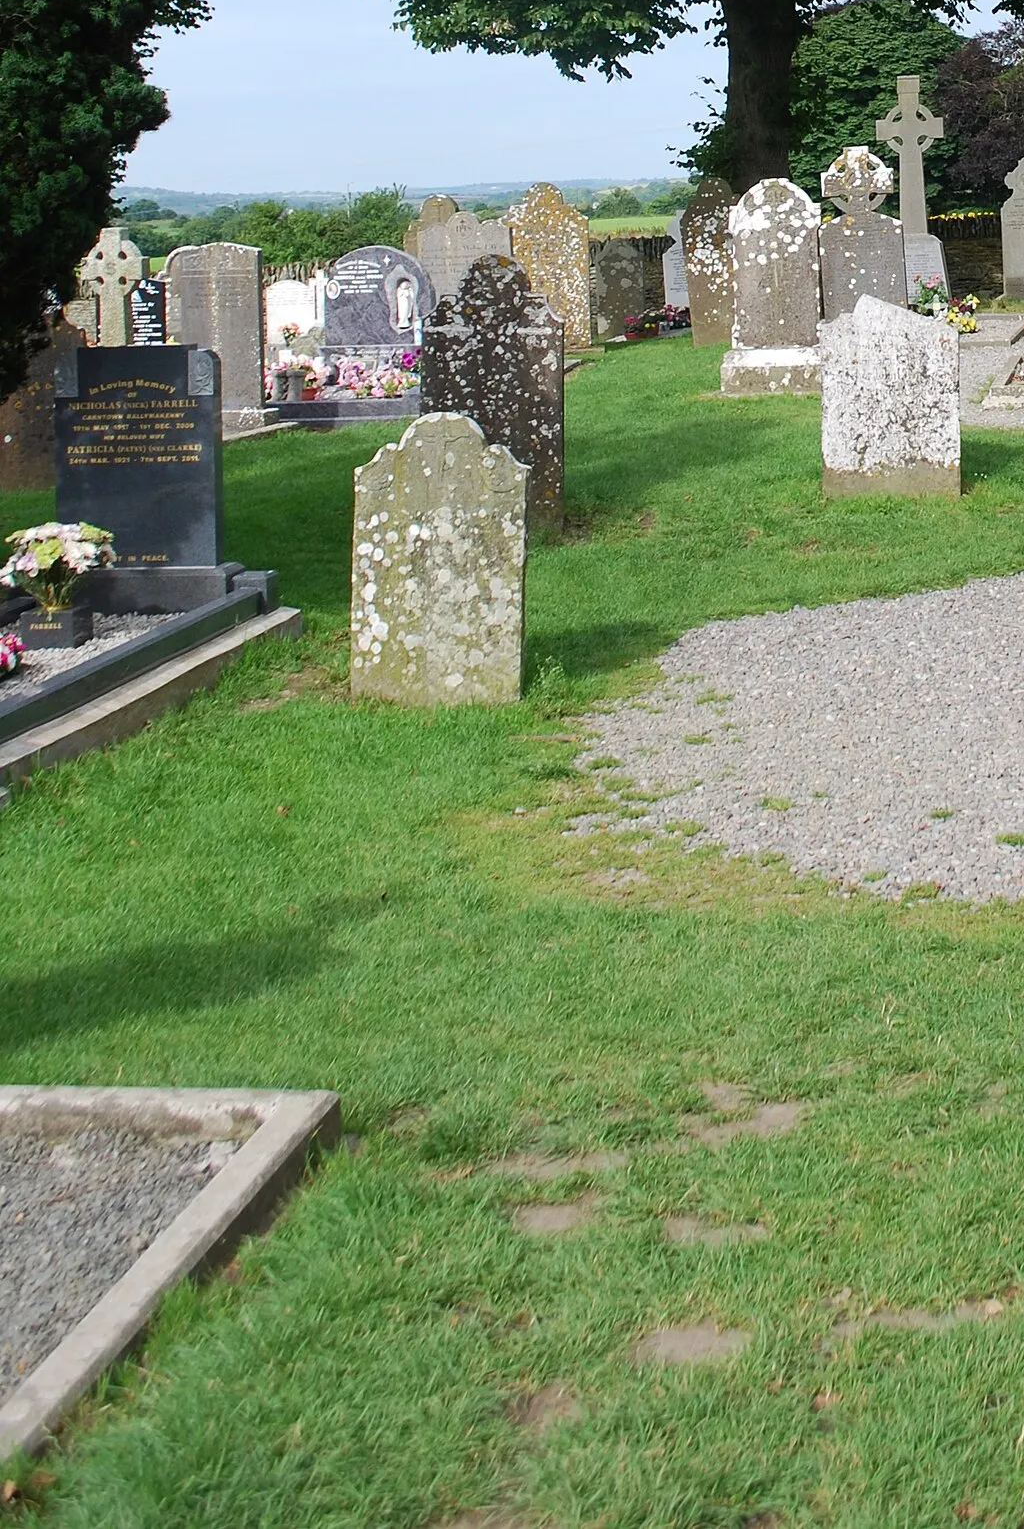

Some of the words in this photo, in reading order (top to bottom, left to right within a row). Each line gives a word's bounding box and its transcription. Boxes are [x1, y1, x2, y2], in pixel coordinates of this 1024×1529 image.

[89, 387, 99, 395] In
[100, 380, 133, 391] Loving
[135, 379, 176, 394] Memory
[68, 401, 121, 410] NICHOLAS
[151, 399, 198, 408] FARRELL
[67, 445, 115, 454] PATRICIA
[167, 443, 202, 453] CLARKE)
[127, 554, 136, 562] IN
[141, 554, 169, 562] PEACE.
